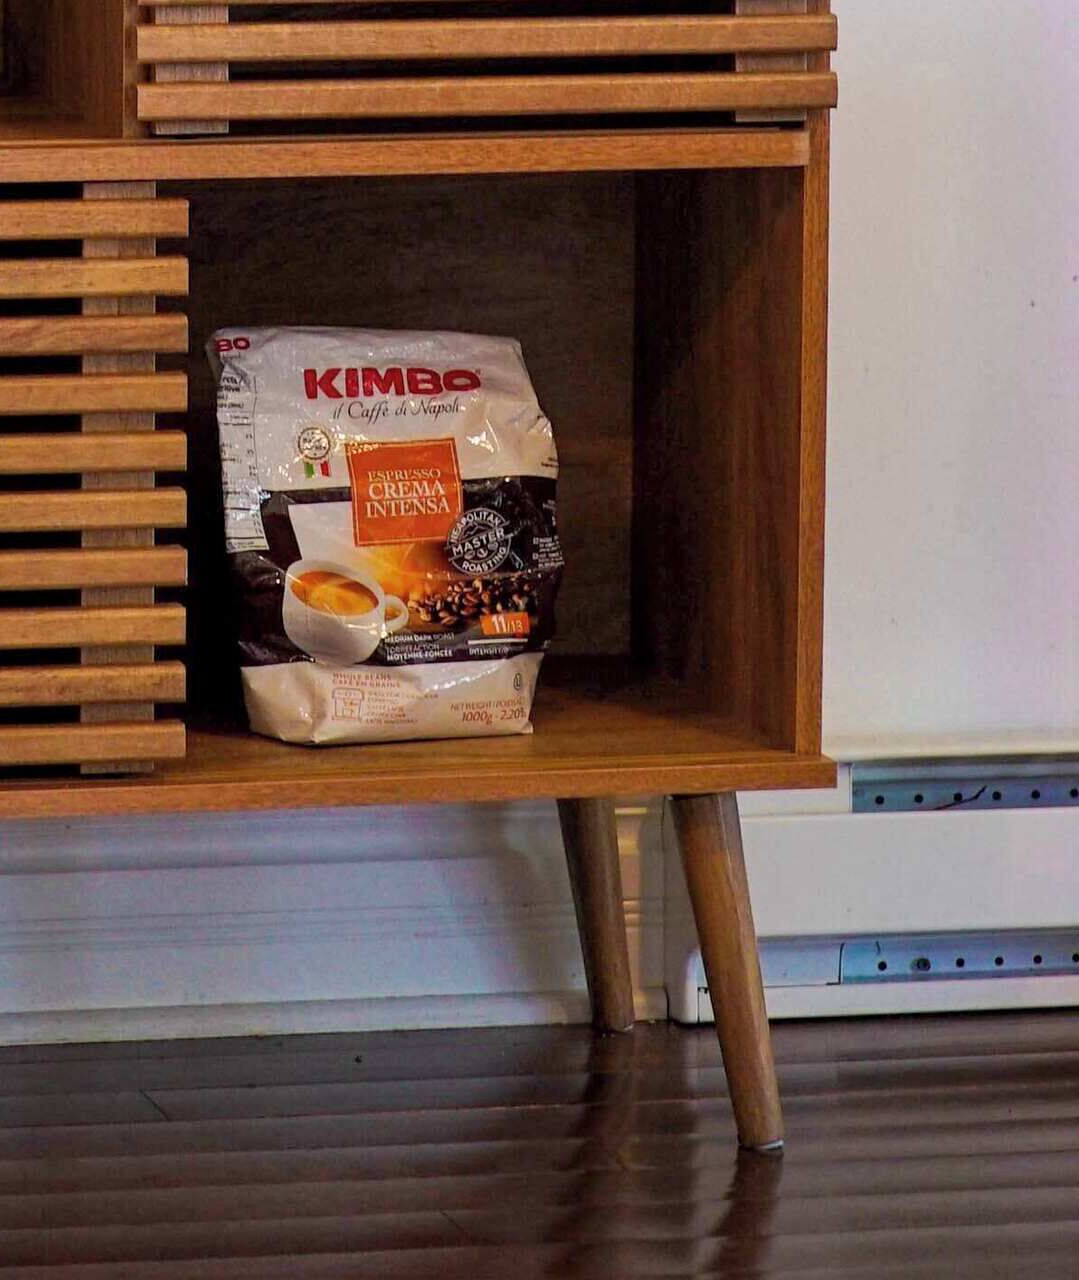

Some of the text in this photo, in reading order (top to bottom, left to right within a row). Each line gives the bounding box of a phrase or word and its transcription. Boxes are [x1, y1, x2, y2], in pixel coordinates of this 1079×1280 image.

[303, 367, 481, 400] KIMBO
[332, 401, 344, 420] il
[395, 401, 407, 418] di
[411, 397, 459, 422] Napoli
[368, 468, 441, 483] ESPRESSO
[369, 480, 446, 500] CREMA
[366, 497, 450, 519] INTENSA
[452, 527, 505, 557] MASTER
[461, 546, 507, 573] ROASTING
